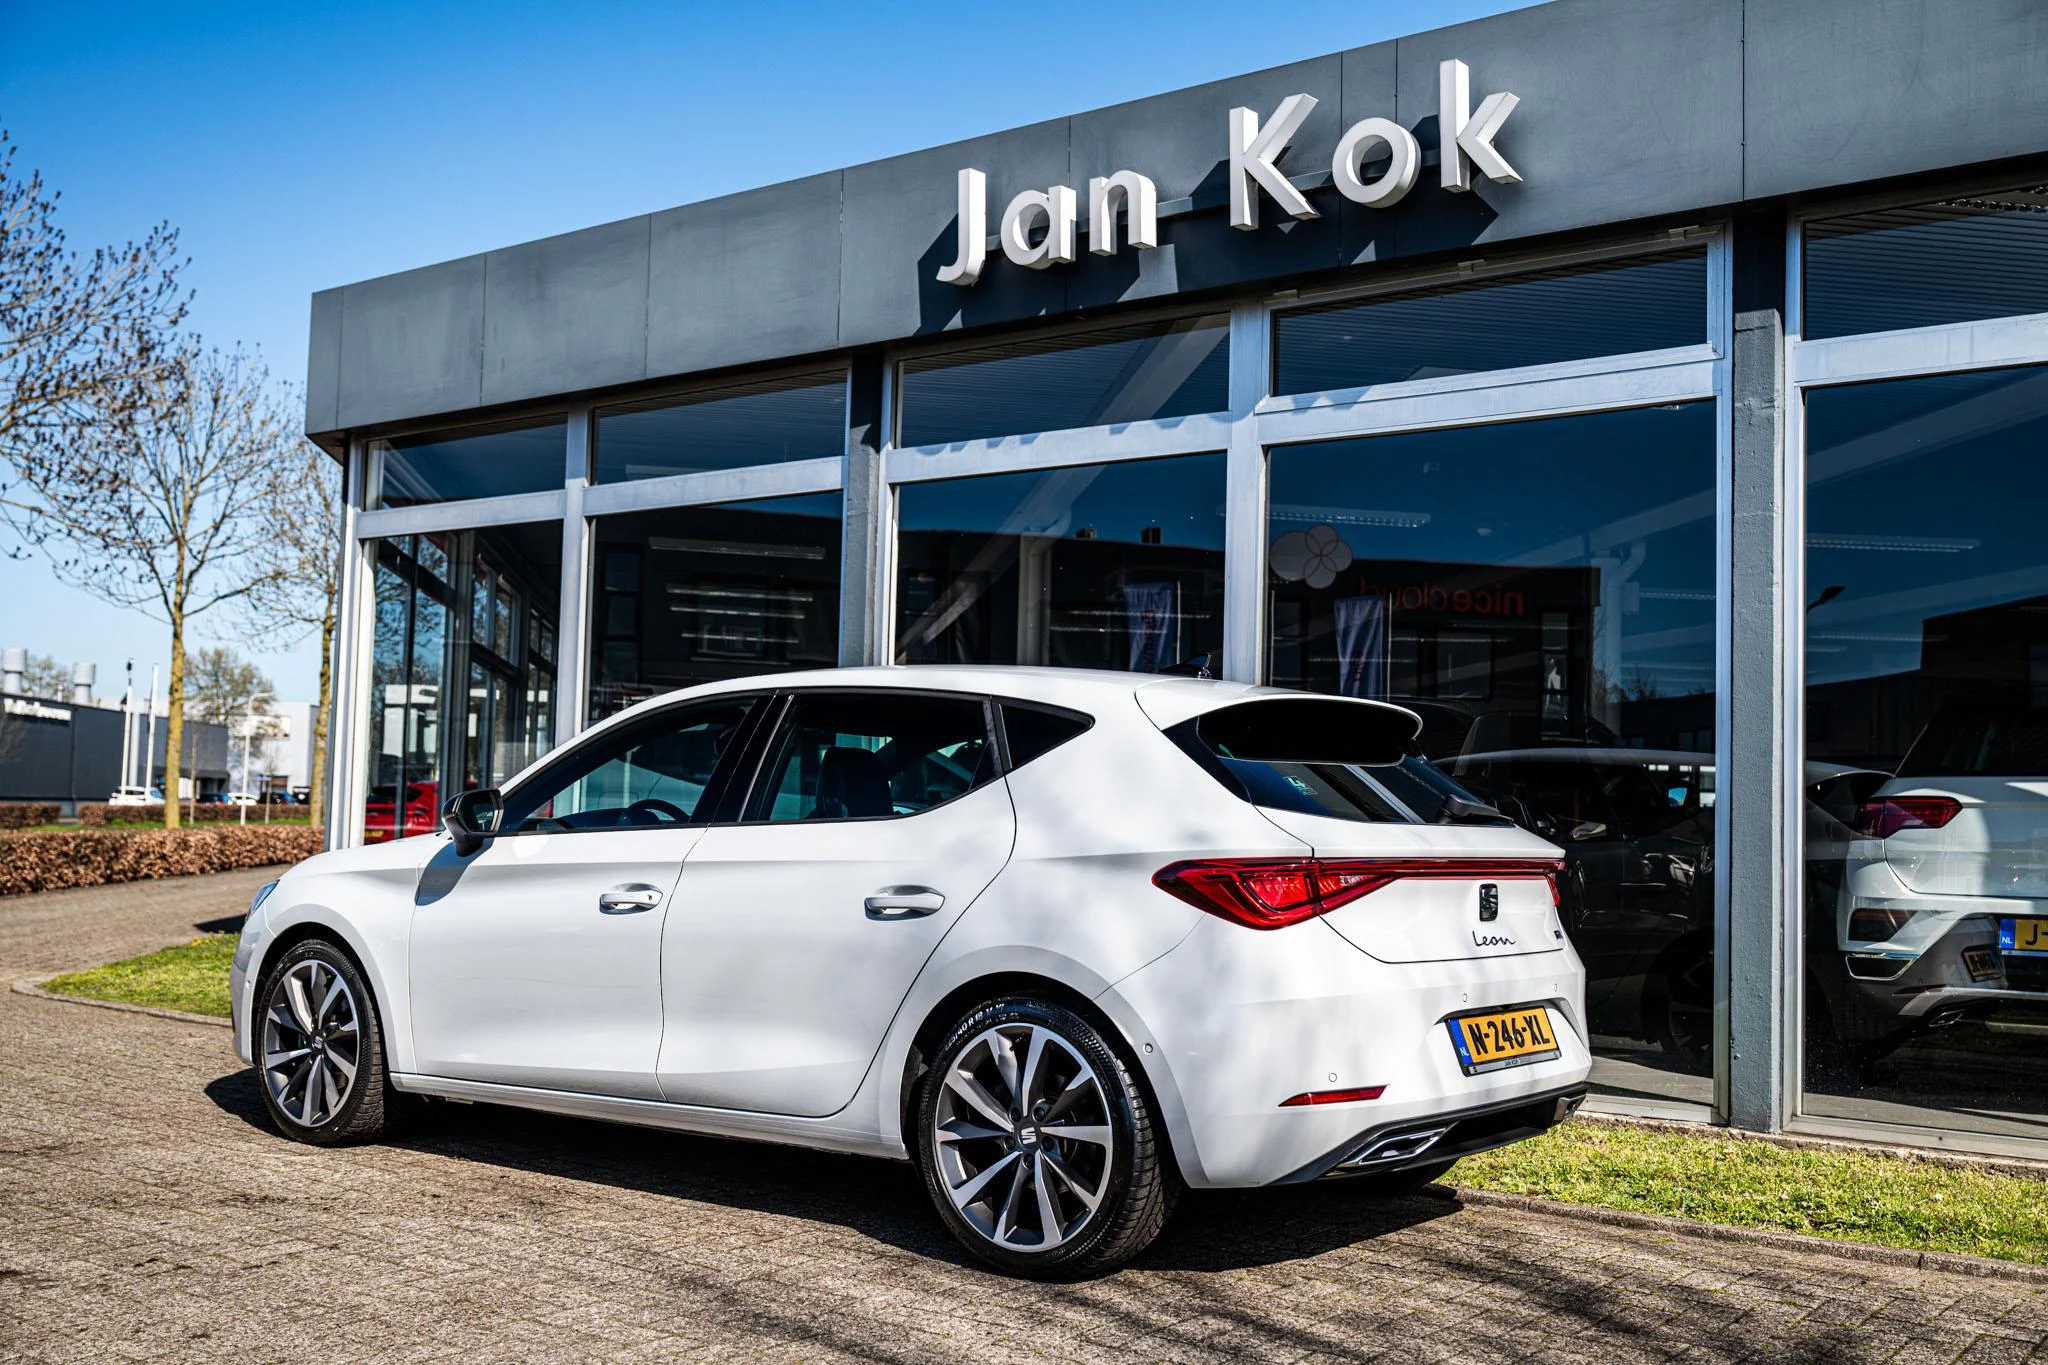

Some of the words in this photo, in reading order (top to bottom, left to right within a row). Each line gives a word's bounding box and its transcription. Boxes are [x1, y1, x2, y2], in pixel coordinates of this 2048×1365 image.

[936, 167, 1158, 286] Jan
[1228, 58, 1524, 231] Kok
[1472, 930, 1516, 947] Leon
[2001, 936, 2013, 944] NL
[1467, 1014, 1550, 1056] N-246-XL
[1460, 1047, 1470, 1057] NL
